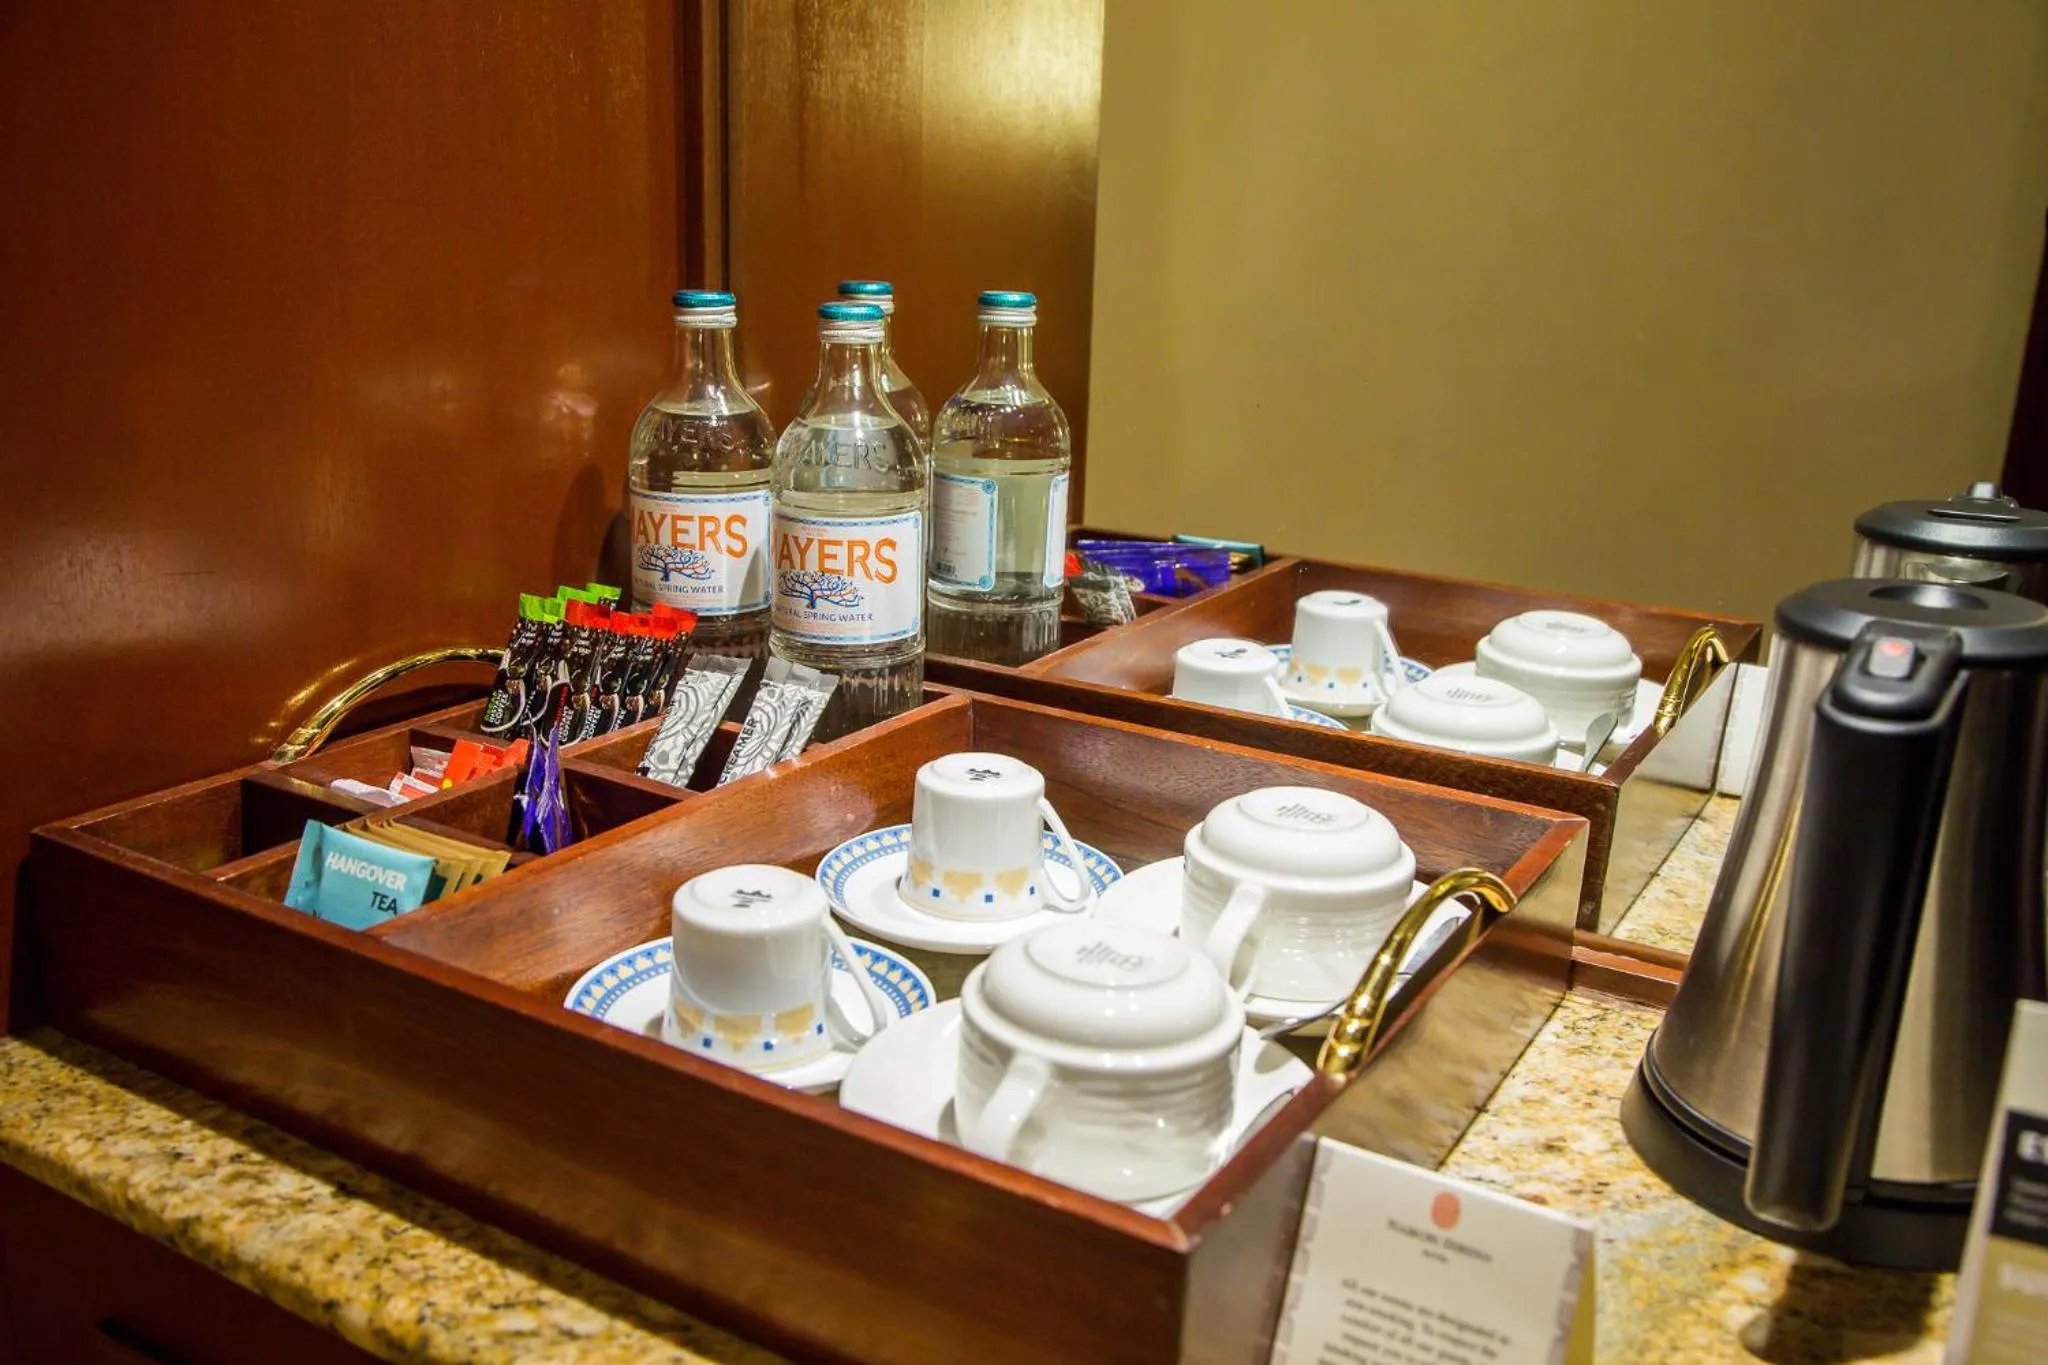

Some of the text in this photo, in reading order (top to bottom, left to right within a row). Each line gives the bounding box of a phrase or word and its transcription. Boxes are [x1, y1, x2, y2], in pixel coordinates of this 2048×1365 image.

[788, 436, 890, 475] AYERS
[632, 508, 748, 559] AYERS
[771, 530, 897, 585] AYERS
[658, 583, 689, 594] SPRING
[691, 585, 725, 595] WATER
[803, 610, 837, 622] SPRING
[839, 612, 873, 622] WATER
[494, 693, 510, 725] COFFEE
[562, 709, 574, 742] COFFEE
[718, 718, 757, 784] CREAMER
[325, 851, 408, 892] HANGOVER
[370, 890, 398, 916] TEA
